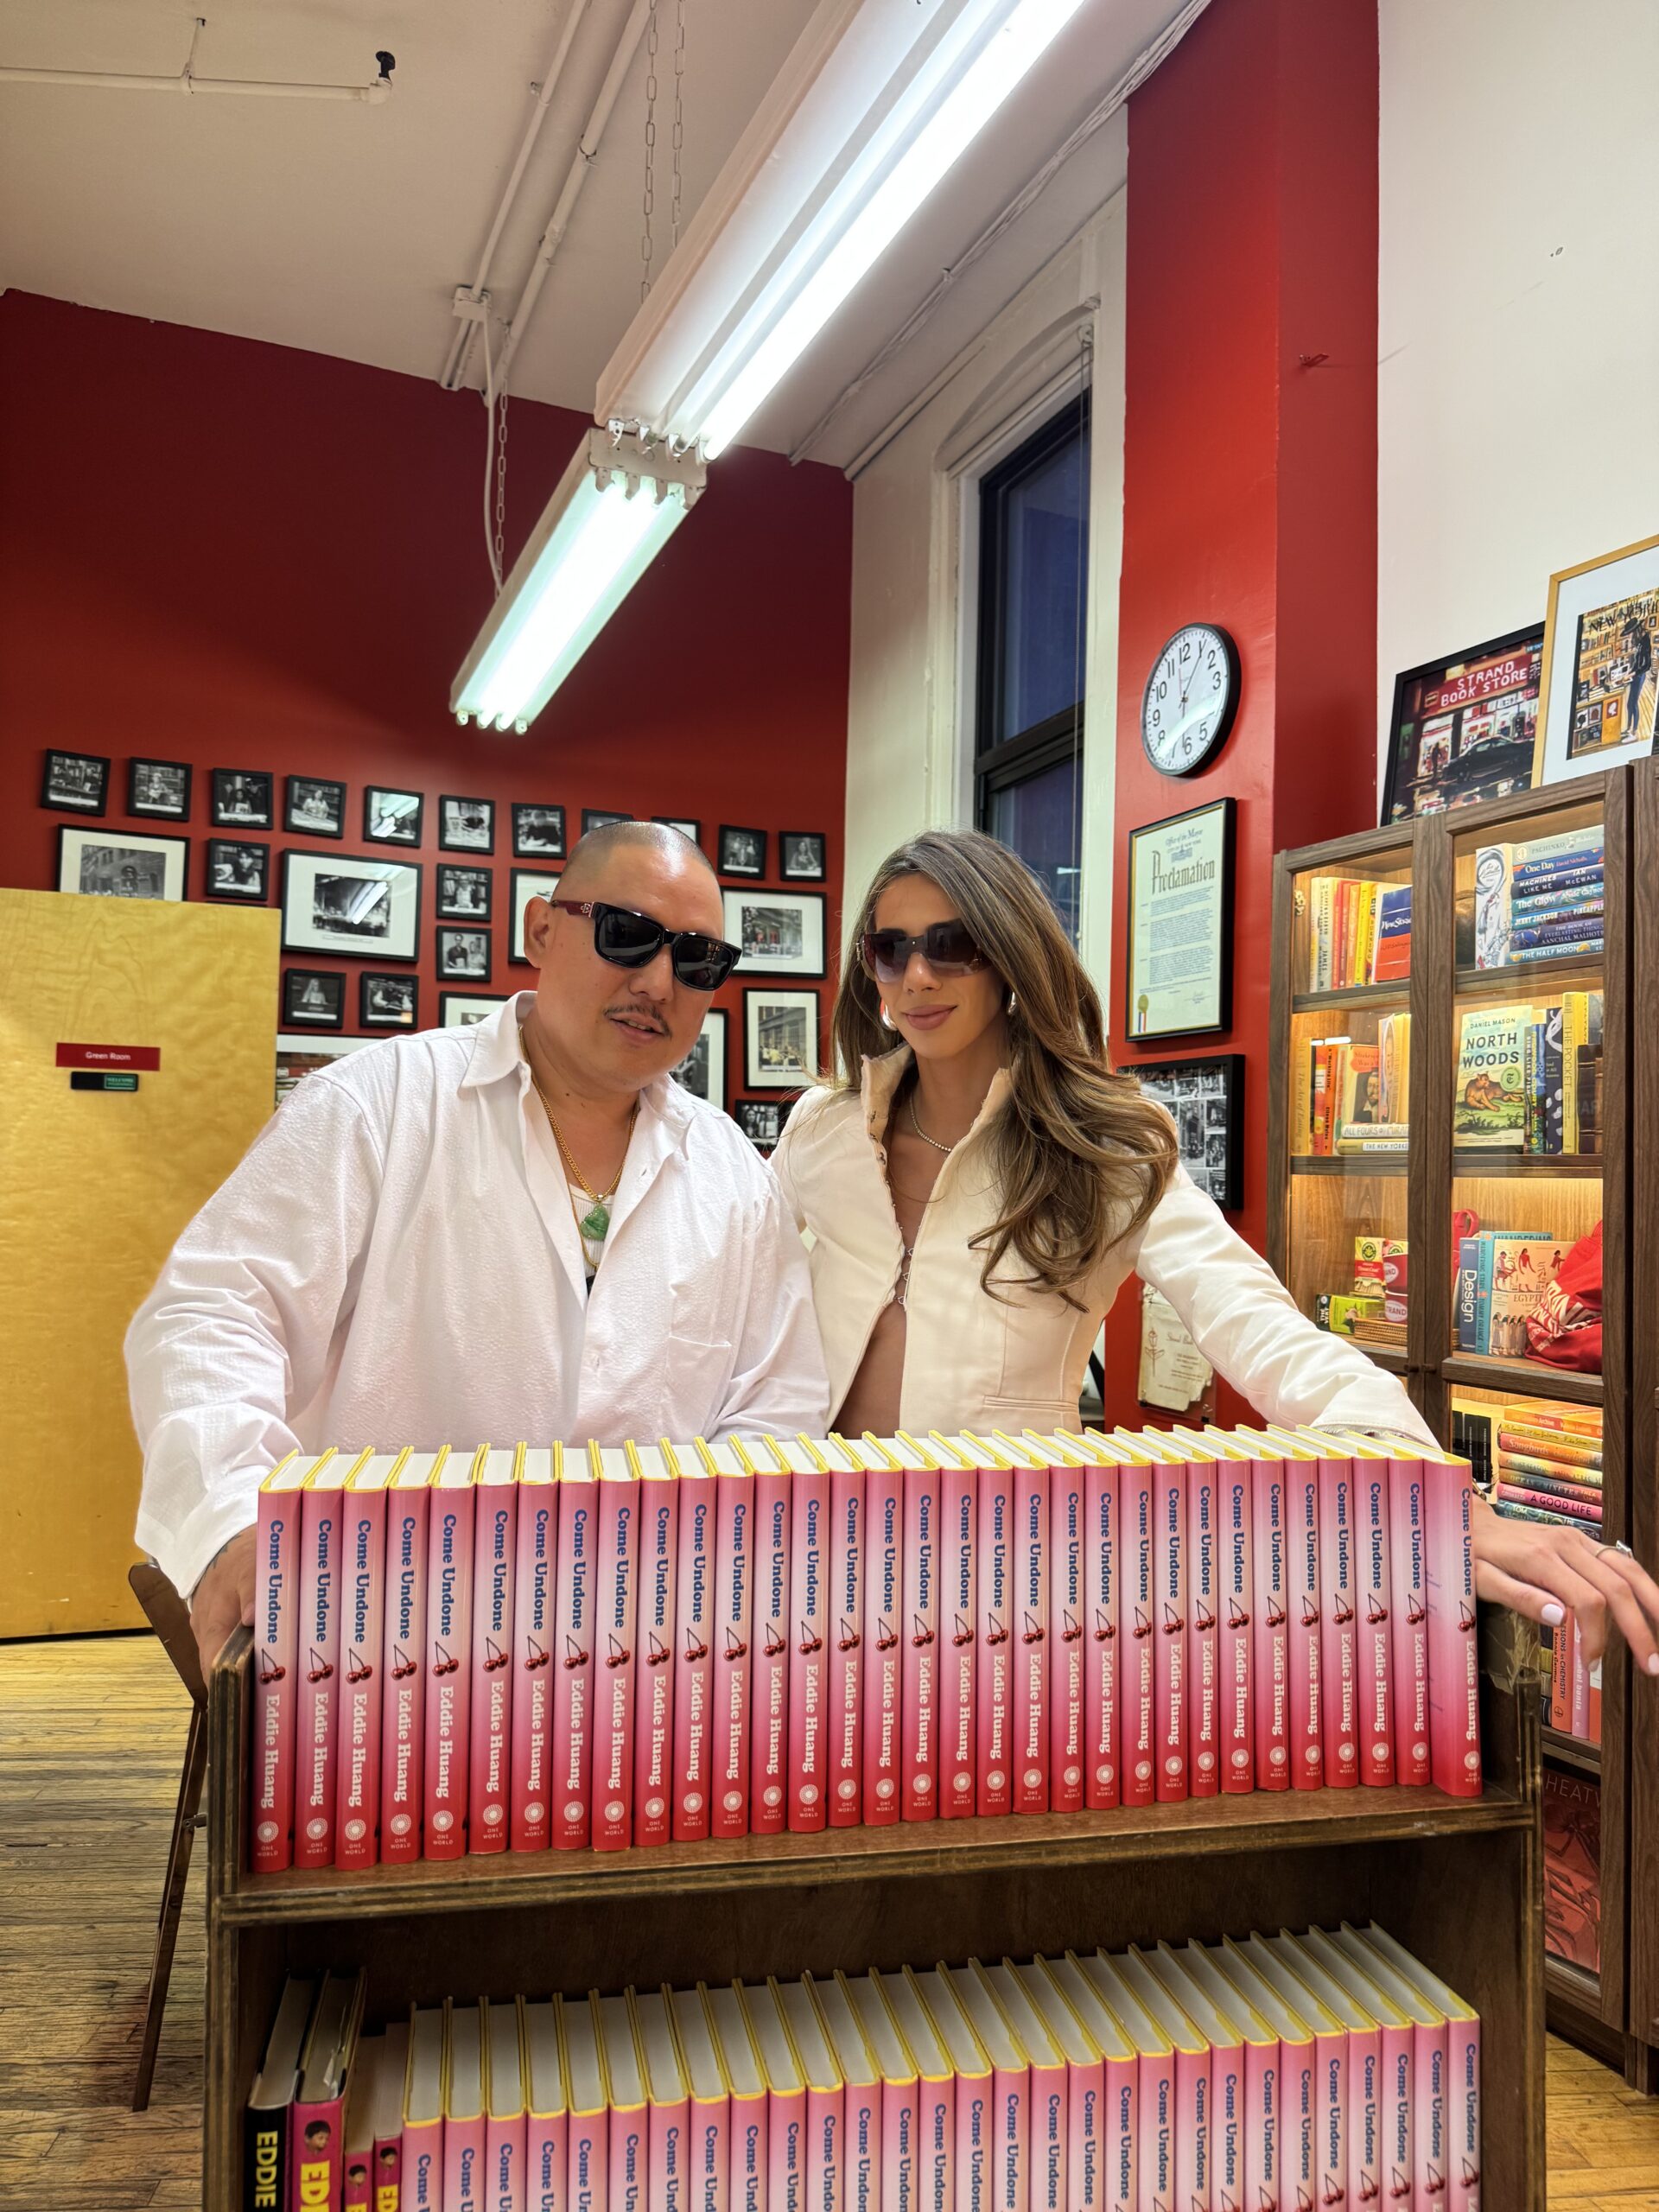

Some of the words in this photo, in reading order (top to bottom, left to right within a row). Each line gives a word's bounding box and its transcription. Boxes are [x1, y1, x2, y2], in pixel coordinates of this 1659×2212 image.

[1167, 658, 1175, 678] 11
[1179, 643, 1191, 664] 12
[1207, 650, 1217, 670] 2
[1457, 661, 1515, 690] STRAND
[1156, 681, 1167, 702] 10
[1212, 671, 1222, 690] 3
[1441, 686, 1477, 707] BOOK
[1483, 668, 1528, 693] STORE
[1153, 709, 1160, 727] 9
[1199, 721, 1208, 741] 5
[1182, 732, 1192, 755] 6
[1152, 850, 1215, 895] Proclamation
[1519, 875, 1557, 887] MACHINES
[1523, 885, 1541, 894] LIKE
[1525, 864, 1541, 874] One
[1541, 862, 1555, 872] Day
[1565, 874, 1597, 885] McEWAN
[1516, 899, 1532, 909] The
[1534, 895, 1556, 906] Glow
[1522, 950, 1535, 959] THE
[1536, 949, 1554, 957] HALF
[1556, 946, 1578, 955] MOON
[1541, 935, 1572, 945] AANCHAL
[1465, 1032, 1518, 1051] NORTH
[1492, 1017, 1516, 1026] MASON
[85, 1051, 108, 1059] Green
[1462, 1051, 1521, 1069] WOODS
[1564, 1046, 1573, 1089] POCKET
[1344, 1126, 1357, 1135] ALL
[1357, 1126, 1378, 1135] FOURS
[1461, 1269, 1478, 1323] Design
[1513, 1293, 1542, 1303] EGYPTI
[733, 1504, 747, 1553] Come
[884, 1498, 896, 1545] Come
[994, 1495, 1007, 1541] Come
[1139, 1492, 1148, 1536] Come
[1231, 1485, 1244, 1530] Come
[1337, 1483, 1347, 1527] Come
[1512, 1505, 1528, 1514] TOM
[1539, 1496, 1569, 1510] GOOD
[1571, 1503, 1592, 1516] LIFE
[269, 1521, 285, 1571] Come
[442, 1515, 458, 1565] Come
[616, 1508, 632, 1557] Come
[883, 1548, 897, 1614] Undone
[994, 1545, 1007, 1610] Undone
[1139, 1540, 1149, 1603] Undone
[1233, 1532, 1246, 1594] Undone
[1338, 1529, 1350, 1591] Undone
[267, 1574, 284, 1645] Undone
[441, 1567, 457, 1637] Undone
[614, 1560, 631, 1630] Undone
[732, 1555, 746, 1623] Undone
[993, 1655, 1005, 1702] Eddie
[1141, 1648, 1150, 1694] Eddie
[1236, 1637, 1247, 1683] Eddie
[1341, 1633, 1352, 1678] Eddie
[611, 1678, 626, 1729] Eddie
[730, 1670, 743, 1720] Eddie
[882, 1660, 895, 1709] Eddie
[1340, 1679, 1353, 1733] Huang
[264, 1693, 282, 1745] Eddie
[439, 1686, 454, 1738] Eddie
[989, 1705, 1005, 1760] Huang
[1137, 1696, 1151, 1751] Huang
[1232, 1684, 1250, 1739] Huang
[607, 1731, 625, 1790] Huang
[725, 1722, 742, 1781] Huang
[878, 1711, 894, 1768] Huang
[260, 1748, 280, 1809] Huang
[435, 1739, 454, 1800] Huang
[1329, 2060, 1342, 2105] Come
[1431, 2051, 1443, 2095] Come
[1084, 2091, 1097, 2138] Come
[1225, 2074, 1238, 2120] Come
[666, 2126, 680, 2176] Come
[1329, 2107, 1343, 2170] Undone
[1432, 2097, 1444, 2160] Undone
[254, 2131, 278, 2208] EDDIE
[1084, 2141, 1097, 2206] Undone
[1225, 2123, 1239, 2187] Undone
[300, 2160, 330, 2212] ED
[417, 2154, 431, 2204] Come
